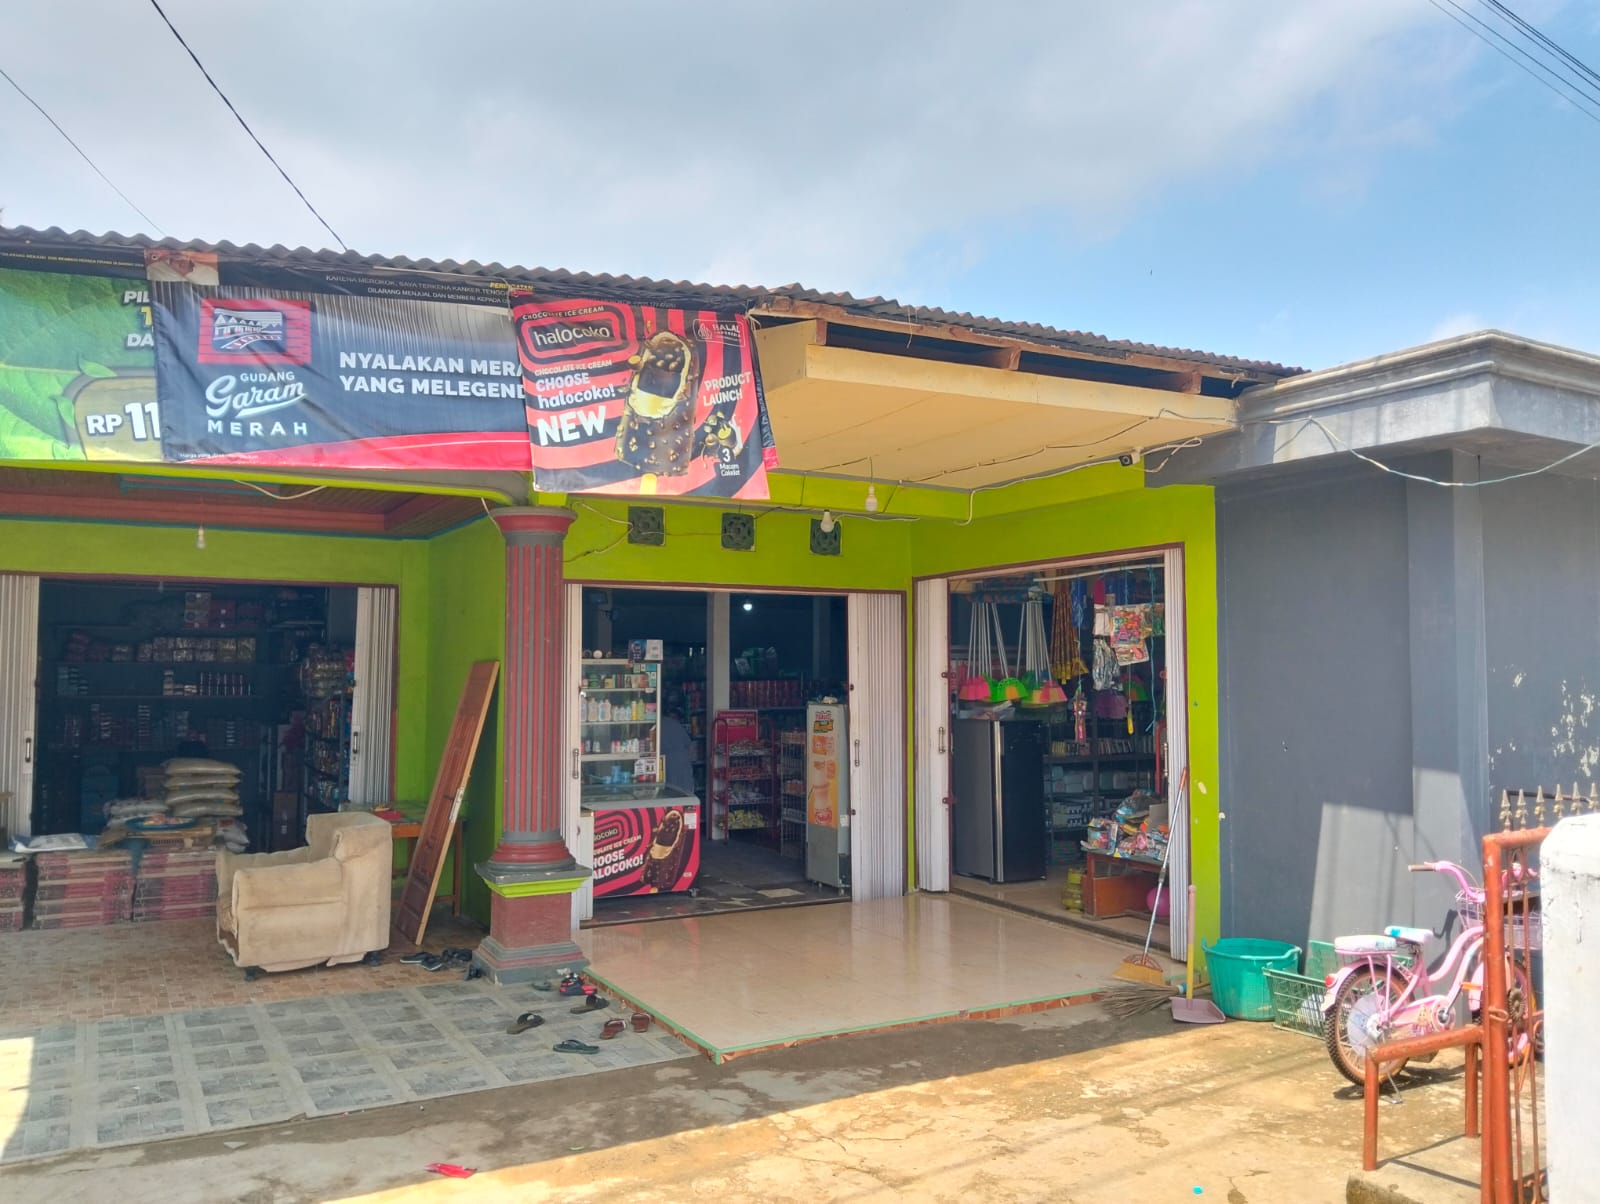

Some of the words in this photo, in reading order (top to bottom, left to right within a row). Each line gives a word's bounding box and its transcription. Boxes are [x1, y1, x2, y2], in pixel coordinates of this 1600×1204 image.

[367, 287, 400, 296] DILARANG
[578, 306, 604, 315] CREAM
[533, 326, 610, 346] halocoko
[712, 323, 740, 333] HALAL
[340, 351, 464, 374] NYALAKAN
[534, 363, 573, 377] CHOCOLATE
[587, 359, 613, 369] CREAM
[240, 371, 296, 382] GUDANG
[339, 375, 405, 393] YANG
[535, 372, 591, 392] CHOOSE
[704, 371, 752, 392] PRODUCT
[205, 374, 305, 418] Garam
[537, 383, 616, 409] halocoko!
[703, 388, 744, 407] LAUNCH
[86, 414, 122, 434] RP
[125, 402, 160, 439] 11
[207, 419, 309, 437] MERAH
[537, 405, 606, 446] NEW
[721, 448, 731, 462] 3
